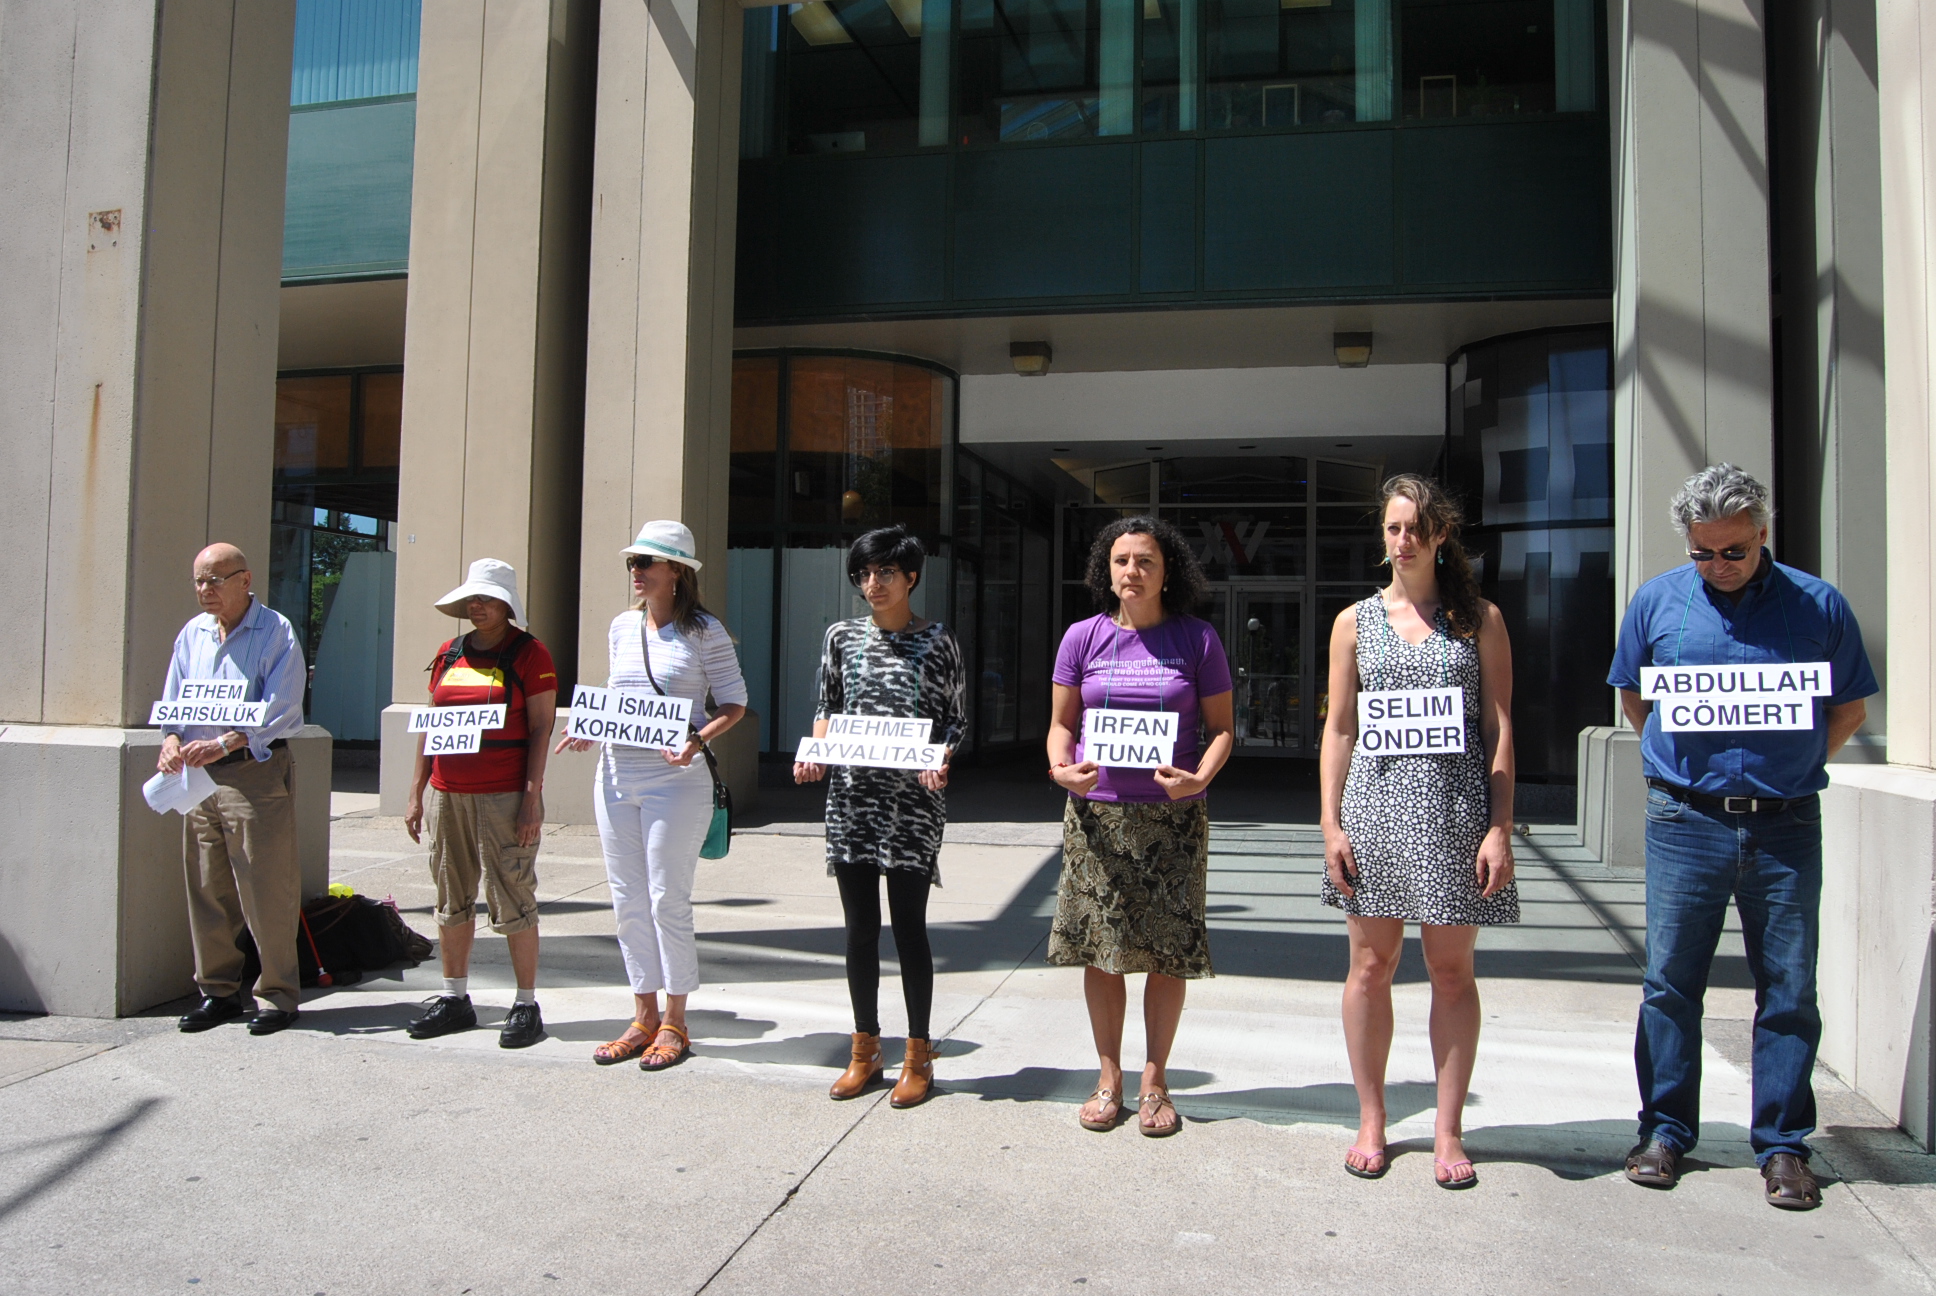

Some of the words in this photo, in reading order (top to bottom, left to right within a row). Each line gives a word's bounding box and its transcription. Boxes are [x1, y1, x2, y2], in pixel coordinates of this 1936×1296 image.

[181, 684, 244, 700] ETHEM
[1651, 670, 1820, 694] ABDULLAH
[157, 703, 260, 723] SARISÜLÜK
[415, 710, 500, 729] MUSTAFA
[574, 692, 608, 712] ALI
[618, 693, 687, 723] İSMAIL
[1367, 695, 1453, 720] SELIM
[1671, 699, 1803, 727] CÖMERT
[574, 717, 680, 748] KORKMAZ
[829, 718, 931, 738] MEHMET
[1093, 711, 1170, 737] İRFAN
[431, 734, 475, 751] SARI
[1362, 724, 1461, 751] ÖNDER
[805, 741, 936, 768] AYVALITAŞ
[1091, 743, 1162, 765] TUNA
